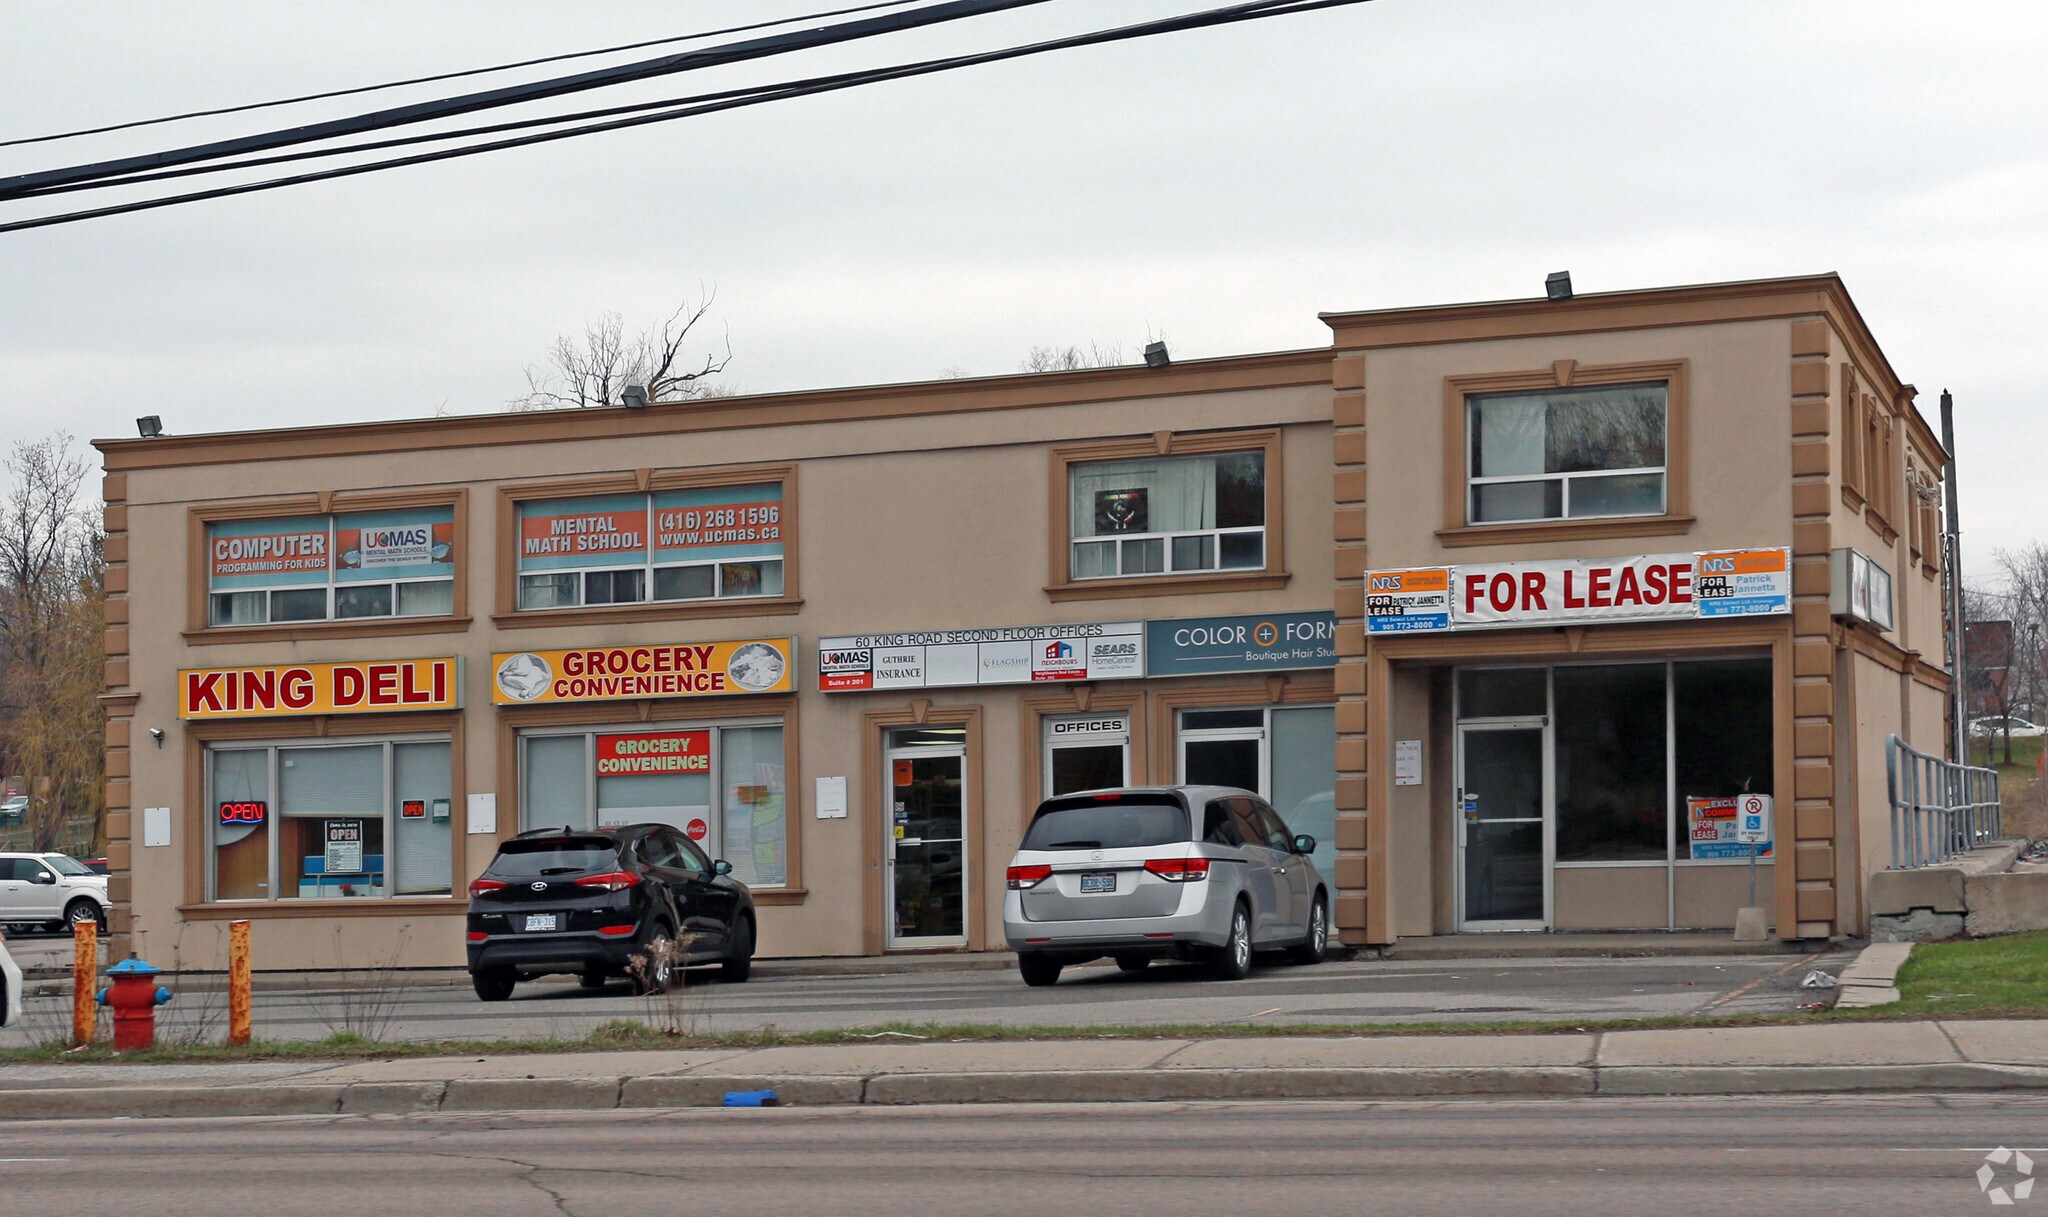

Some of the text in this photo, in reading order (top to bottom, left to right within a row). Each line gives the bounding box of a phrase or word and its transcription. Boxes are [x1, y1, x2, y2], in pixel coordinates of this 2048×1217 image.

[551, 516, 617, 535] MENTAL
[659, 506, 779, 531] (416) 268 1596
[366, 529, 427, 548] UCMAS
[525, 532, 643, 554] MATH SCHOOL
[660, 526, 779, 546] www.ucmas.ca
[215, 534, 326, 560] COMPUTER
[216, 557, 326, 574] PROGRAMMING FOR KIDS
[1703, 557, 1735, 573] NRS
[1372, 576, 1402, 591] NRS
[1465, 563, 1692, 613] FOR LEASE
[1701, 574, 1772, 587] FOR Patrick
[1697, 583, 1776, 598] LEASE Jannetta
[1369, 595, 1444, 606] FOR PATRICK JANNETTA
[1367, 606, 1402, 616] LEASE
[1730, 604, 1770, 613] 773-8000
[1396, 621, 1433, 630] 773-8000
[855, 625, 1103, 648] 60 KING ROAD SECOND FLOOR OFFICES
[1174, 626, 1246, 647] COLOR
[1093, 643, 1136, 655] SEARS
[1246, 650, 1289, 662] Boutique
[1292, 648, 1314, 659] Hair
[562, 645, 716, 677] GROCERY
[822, 651, 869, 665] UCMAS
[882, 655, 916, 664] GUTHRIE
[991, 658, 1029, 666] FLAGSHIP
[876, 668, 921, 679] INSURANCE
[187, 662, 446, 713] KING DELI
[553, 671, 725, 698] CONVENIENCE
[1055, 720, 1122, 733] OFFICES
[615, 738, 691, 755] GROCERY
[598, 755, 709, 773] CONVENIENCE
[221, 803, 264, 820] OPEN
[403, 804, 424, 816] OPEN
[1698, 820, 1713, 829] FOR
[330, 829, 358, 840] OPEN
[1693, 830, 1717, 839] LEASE
